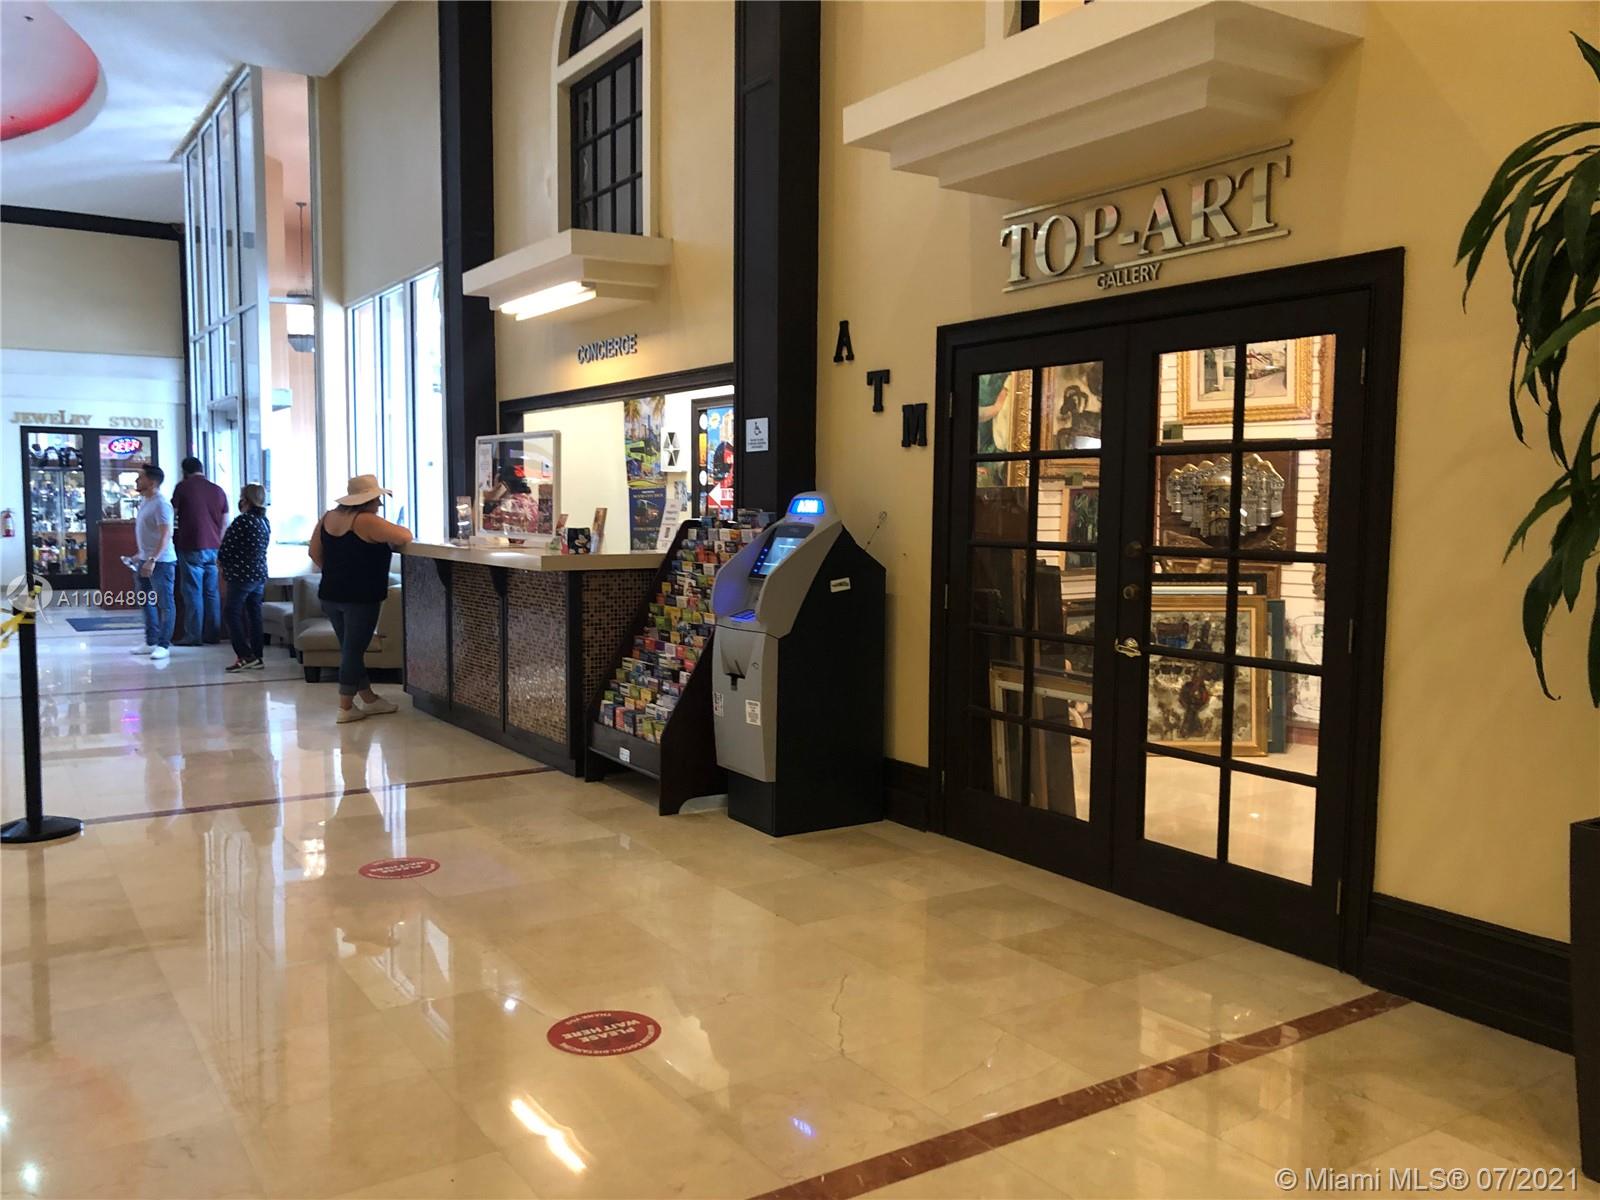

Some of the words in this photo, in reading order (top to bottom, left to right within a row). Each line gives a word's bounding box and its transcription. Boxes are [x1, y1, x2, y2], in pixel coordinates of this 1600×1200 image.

[1000, 153, 1292, 286] TOP-ART
[1096, 261, 1163, 291] GALLERY
[577, 333, 638, 365] CONCIERGE
[9, 409, 93, 426] JEWELRY
[108, 416, 165, 430] STORE
[561, 1026, 603, 1040] HERE
[578, 1026, 637, 1043] PLEASE
[603, 1019, 641, 1032] WAIT
